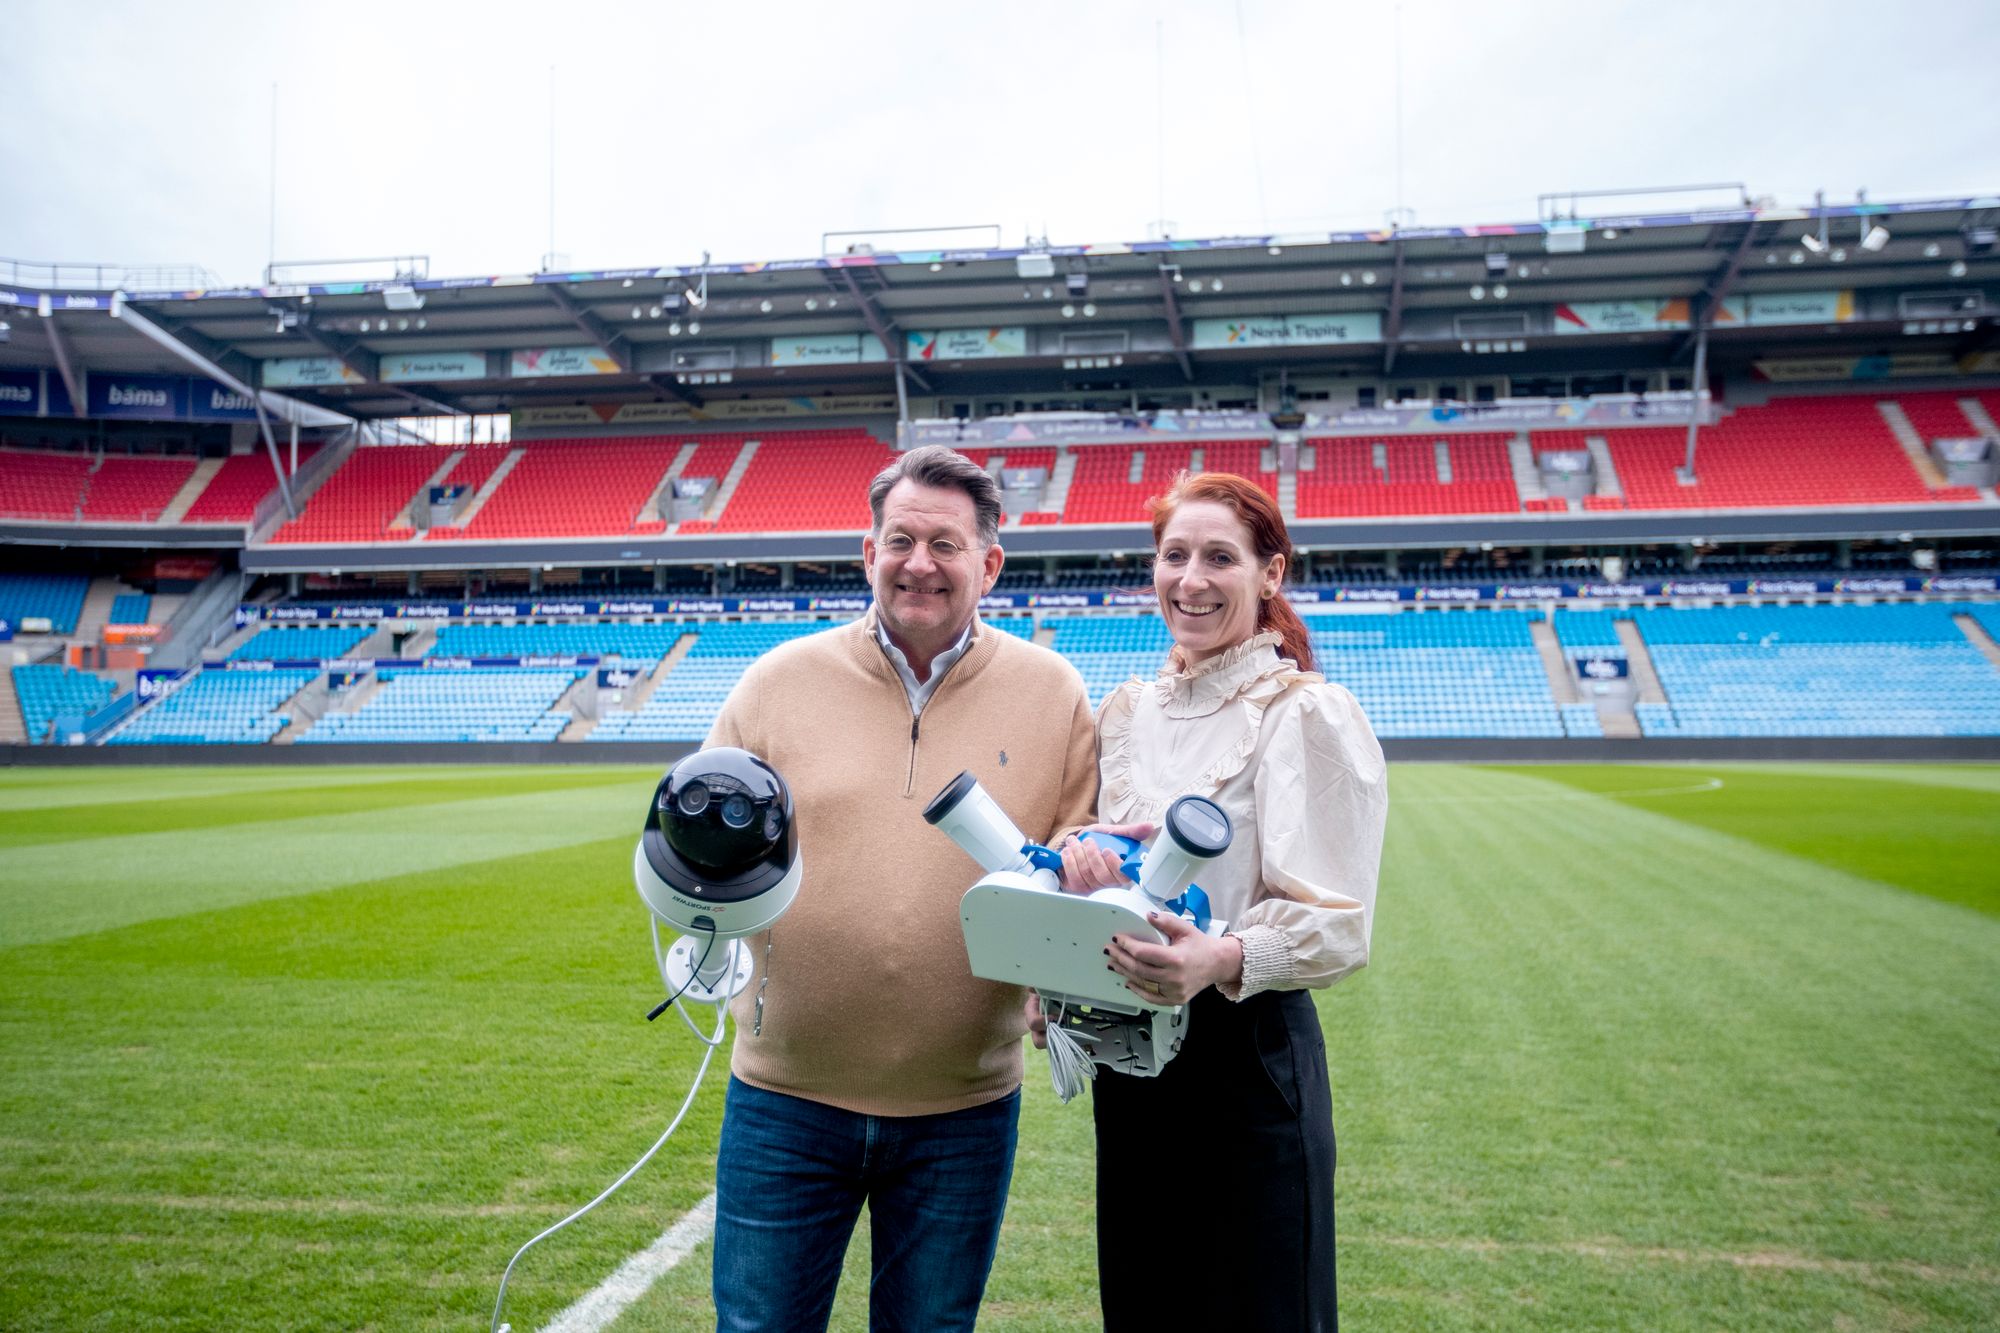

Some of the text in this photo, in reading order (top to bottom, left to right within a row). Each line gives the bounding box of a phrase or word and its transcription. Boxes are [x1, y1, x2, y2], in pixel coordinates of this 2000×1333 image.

[1251, 321, 1347, 339] Norsk Tipping
[0, 384, 32, 402] ma
[108, 384, 167, 407] bama
[211, 388, 258, 411] bam
[672, 896, 711, 911] SPORTWAY
